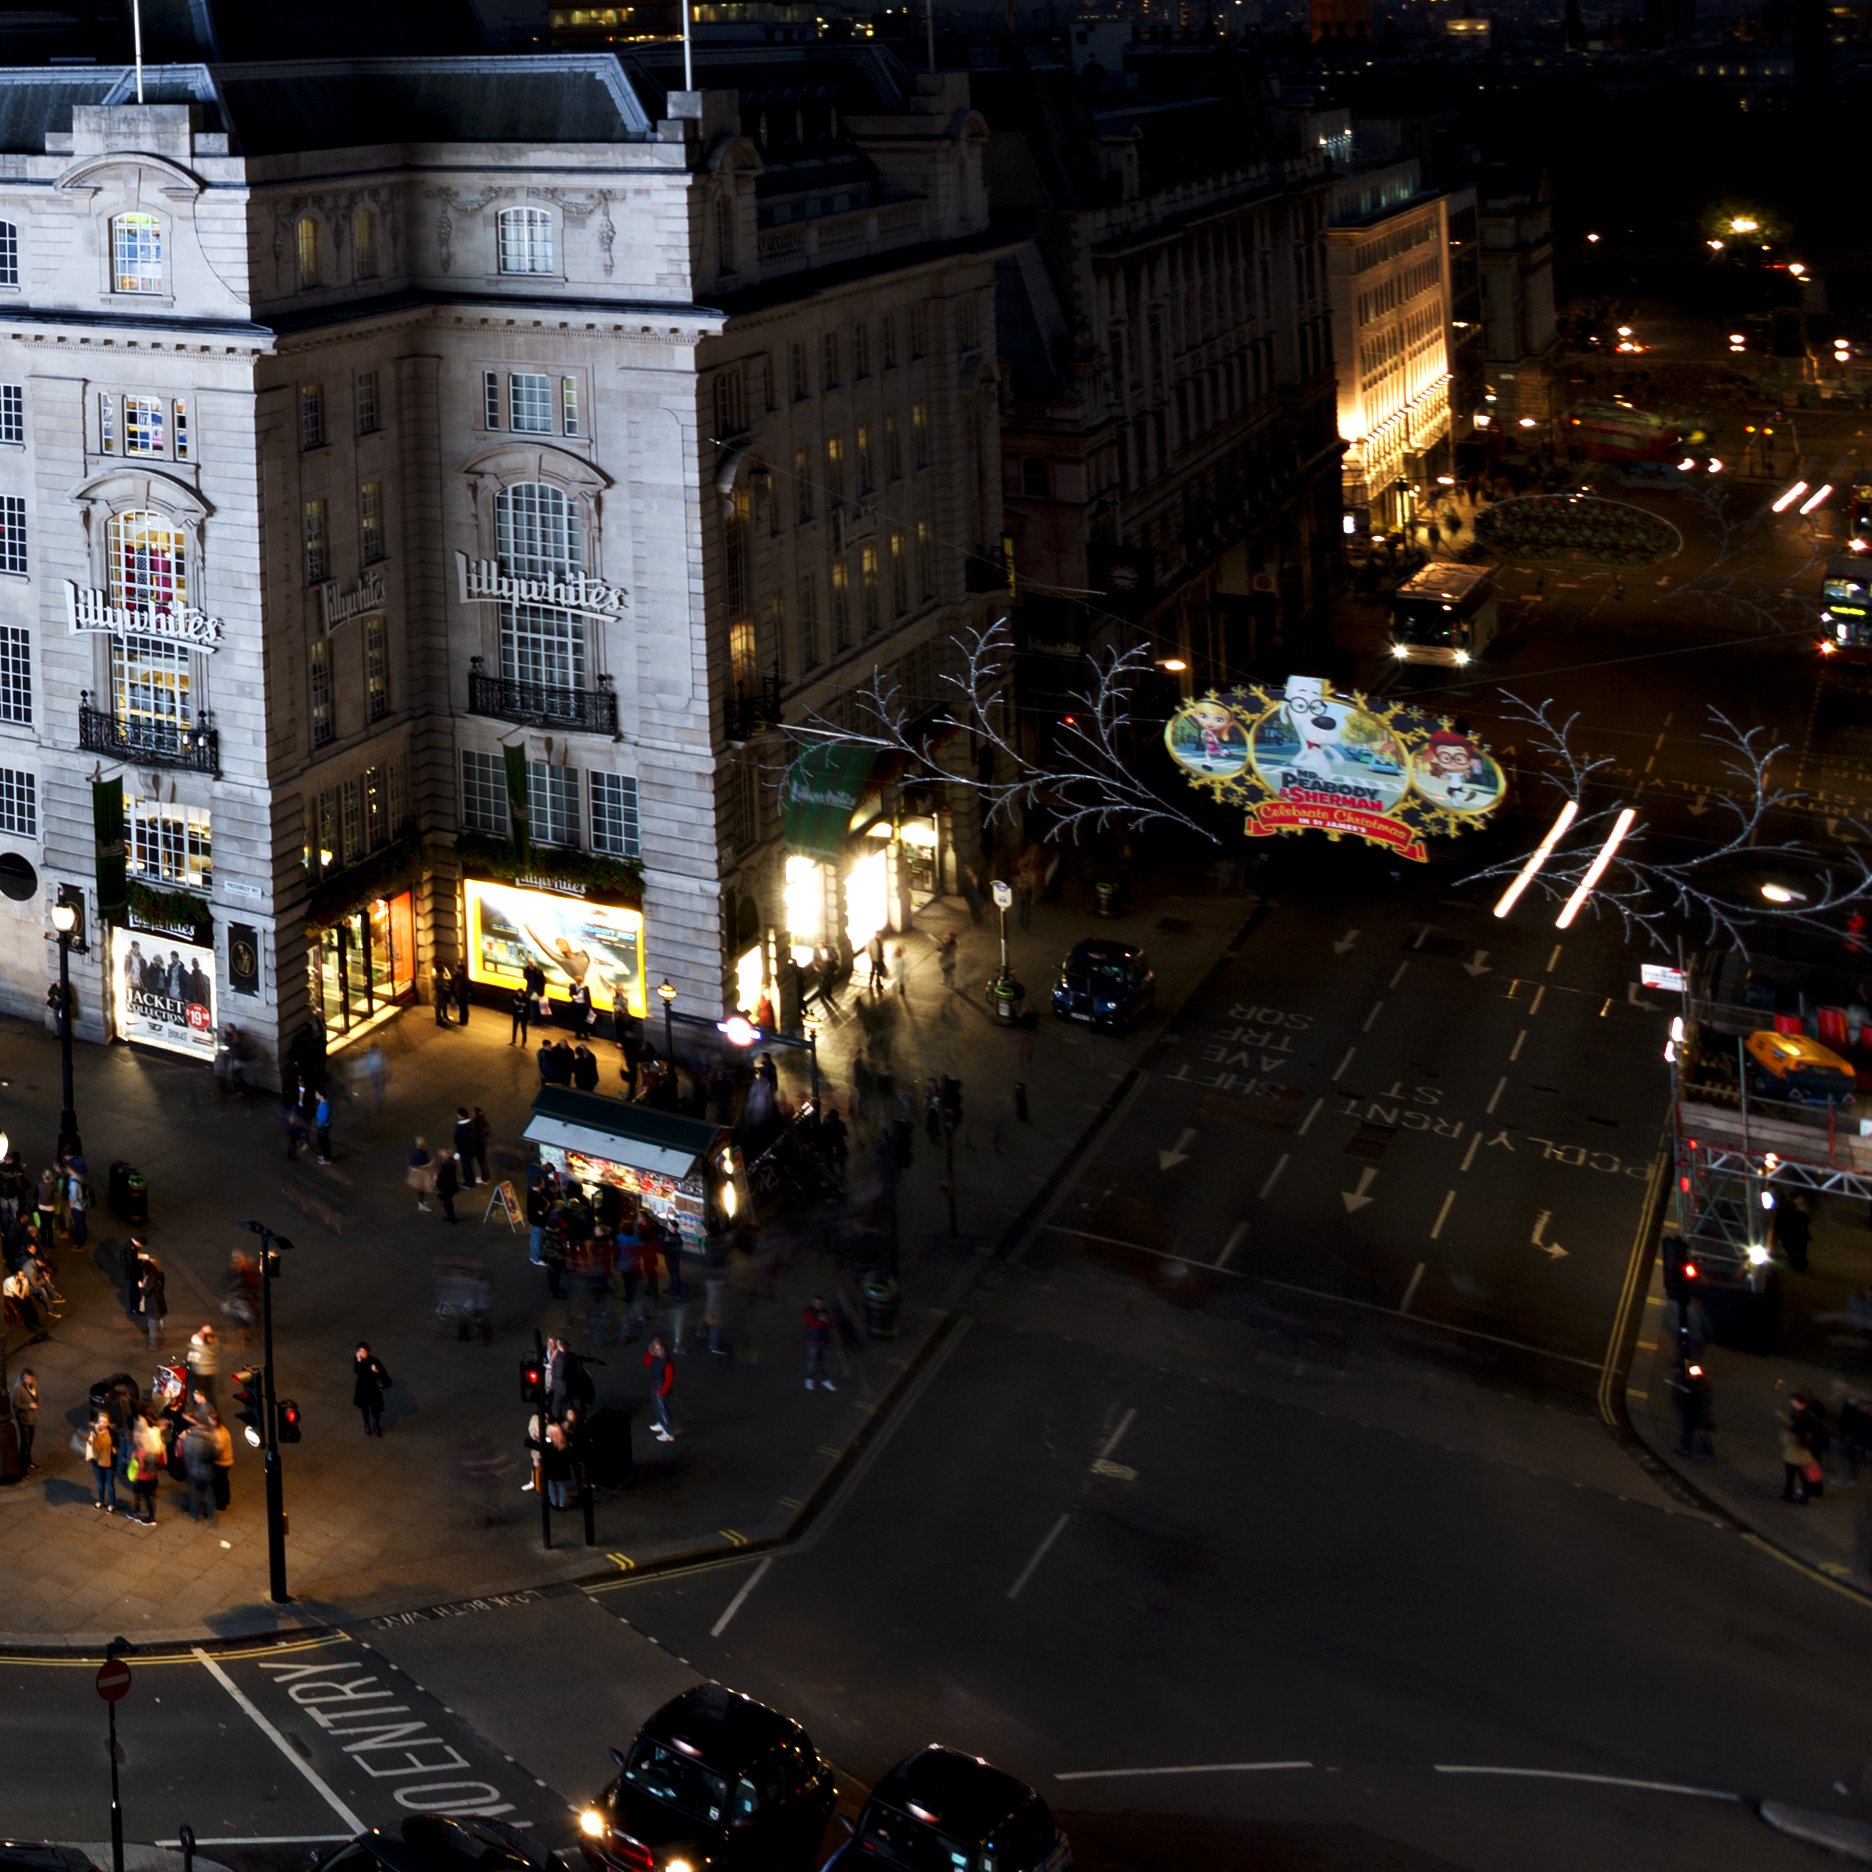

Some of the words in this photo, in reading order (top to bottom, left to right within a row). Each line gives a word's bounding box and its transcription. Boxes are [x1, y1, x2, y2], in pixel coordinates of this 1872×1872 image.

[456, 550, 624, 623] Lillywhites
[64, 578, 220, 655] Lillywhites
[322, 571, 386, 636] Lillywhites
[1281, 771, 1380, 800] PEABODY
[1260, 804, 1330, 821] Celebrate
[1333, 808, 1407, 839] Christmas
[126, 1003, 186, 1025] COLLECTION
[127, 988, 185, 1014] JACKET
[1227, 1000, 1316, 1031] SQR
[1213, 1026, 1295, 1054] TRF
[1200, 1045, 1287, 1073] AVE
[1379, 1079, 1444, 1106] ST
[1339, 1099, 1465, 1140] RGNT
[1486, 1129, 1657, 1181] PCDLY
[258, 1660, 472, 1778] ENTRY
